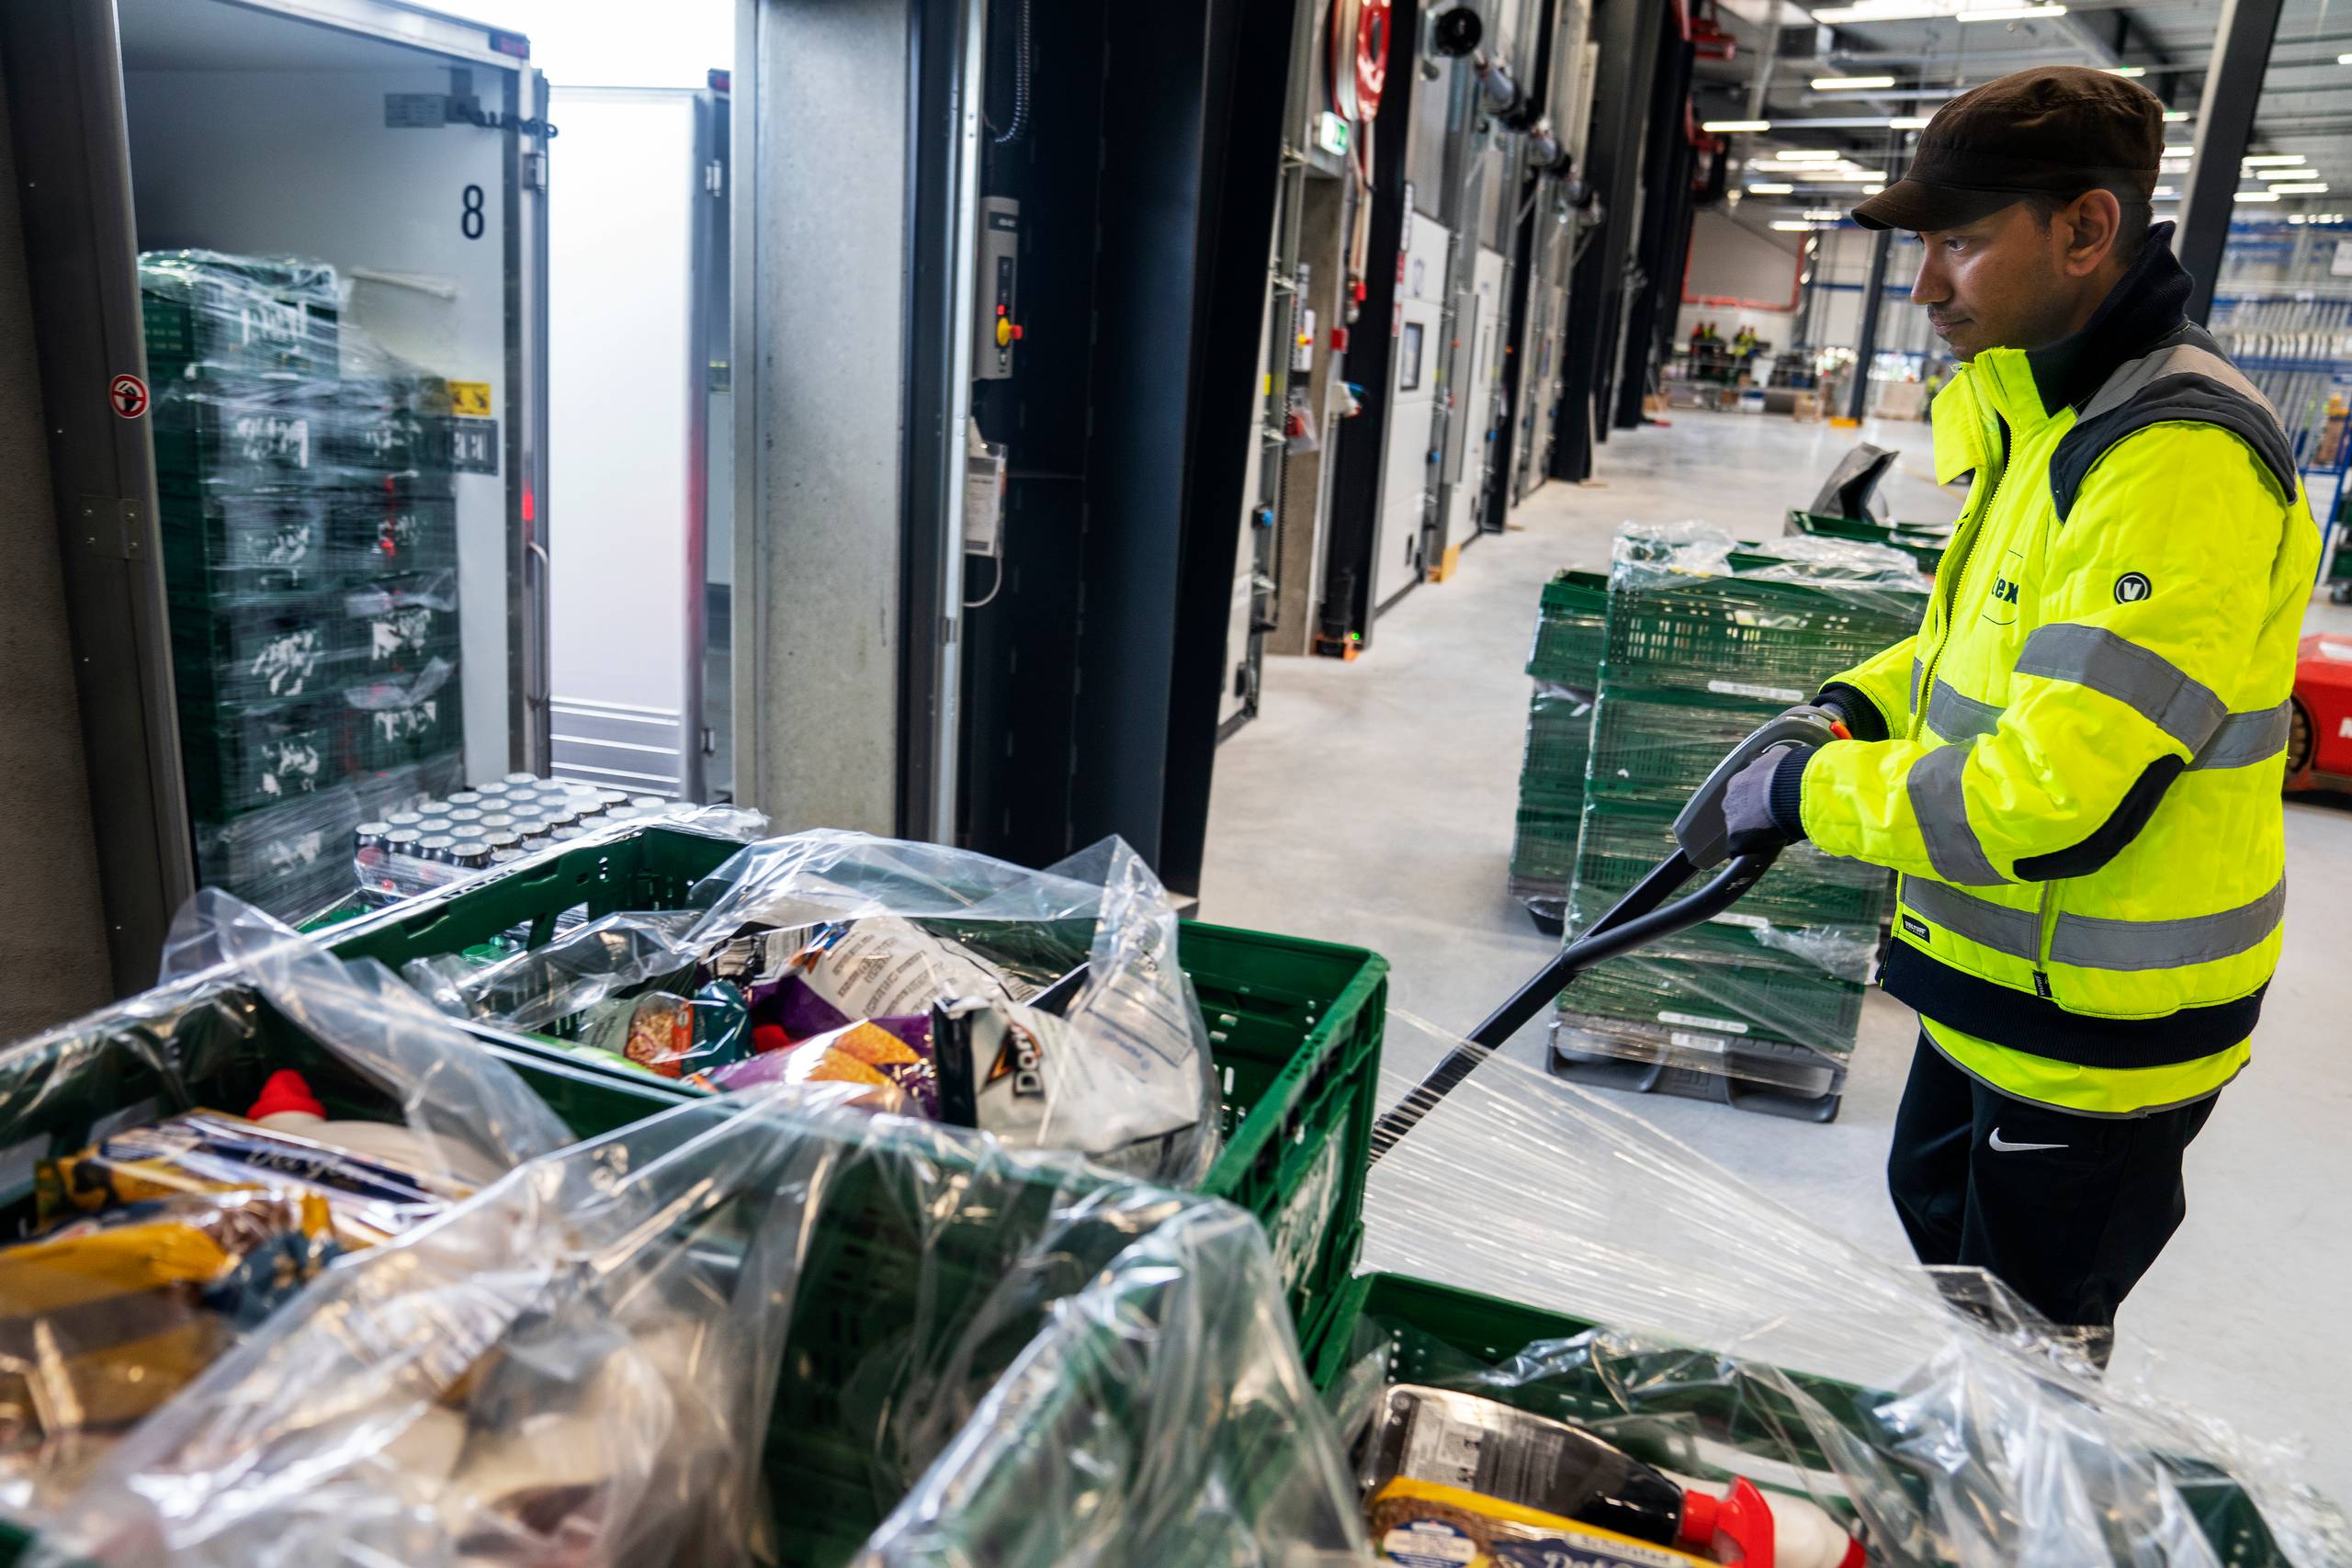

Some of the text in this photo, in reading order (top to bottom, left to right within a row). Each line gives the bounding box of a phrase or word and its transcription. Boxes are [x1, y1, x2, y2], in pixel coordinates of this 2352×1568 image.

[461, 185, 485, 241] 8
[1992, 571, 2019, 604] ex
[2123, 581, 2143, 601] V
